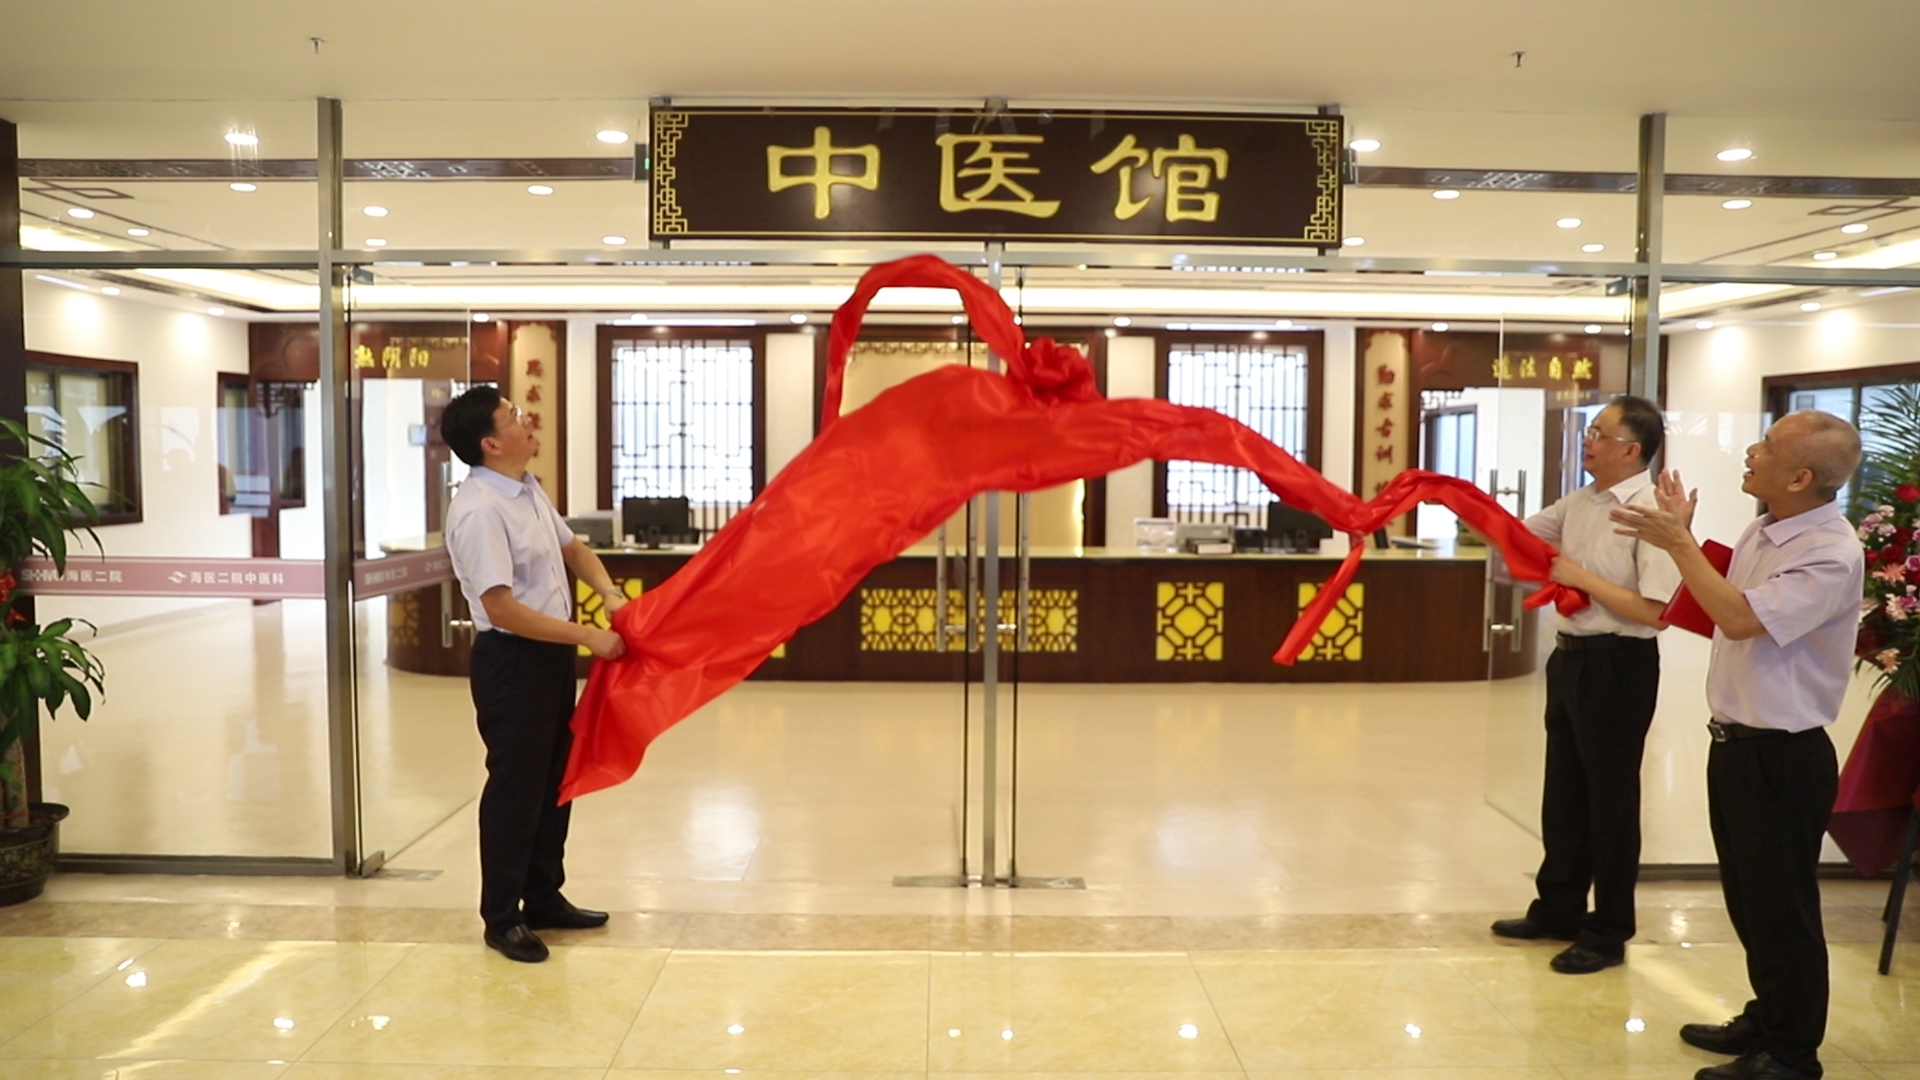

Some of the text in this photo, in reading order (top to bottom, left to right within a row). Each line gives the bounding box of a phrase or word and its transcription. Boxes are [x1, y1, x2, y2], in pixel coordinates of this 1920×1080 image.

[767, 126, 1229, 222] 中医馆
[1491, 355, 1594, 380] 道法自然
[190, 571, 284, 585] 海医二院中医科
